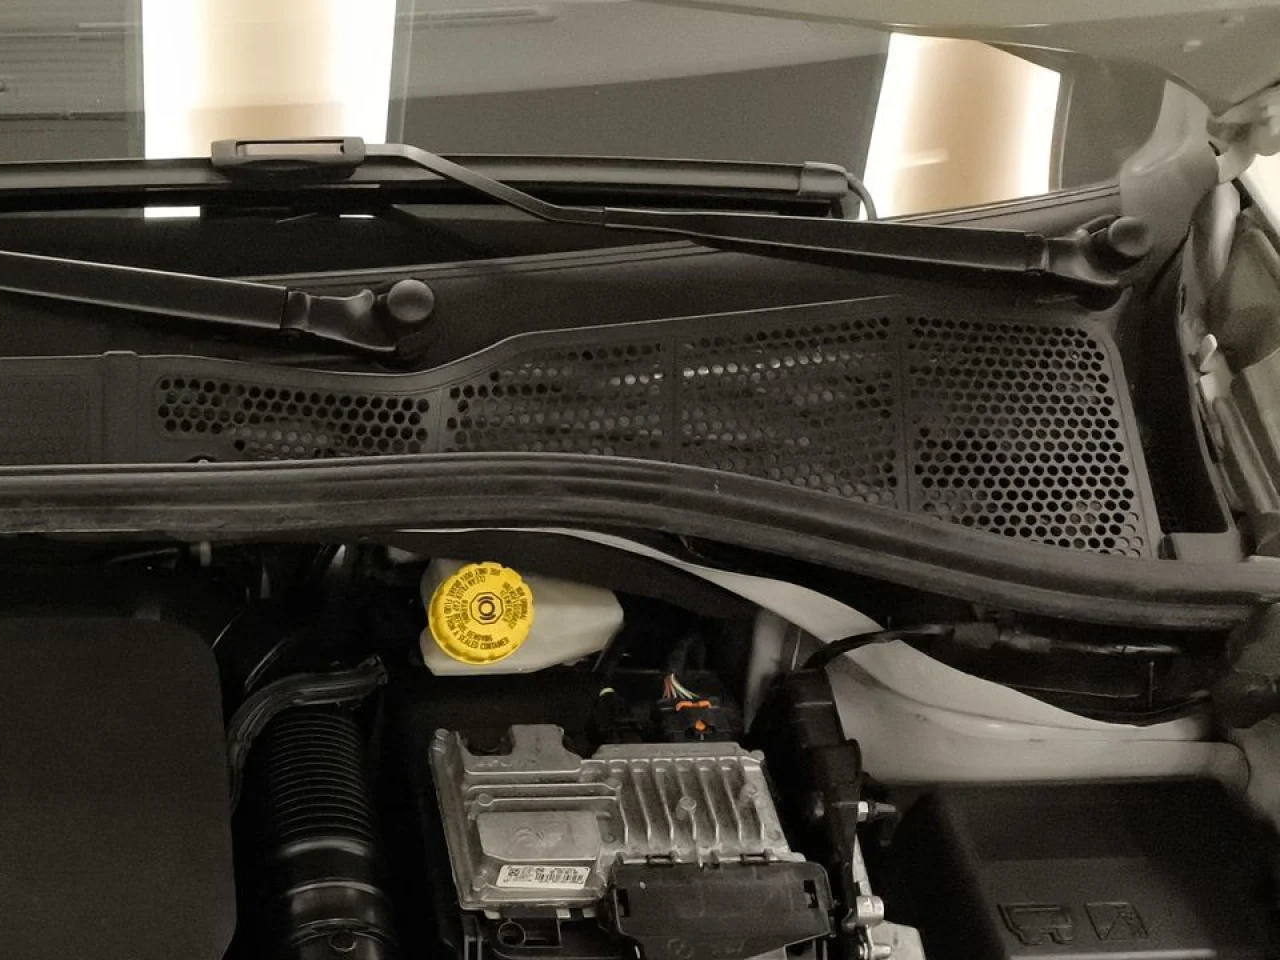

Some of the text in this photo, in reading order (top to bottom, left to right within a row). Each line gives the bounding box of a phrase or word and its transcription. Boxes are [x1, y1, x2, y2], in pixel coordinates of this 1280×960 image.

[467, 575, 486, 587] CLEAN
[443, 598, 453, 615] FLUID
[452, 599, 461, 612] CAP
[445, 614, 456, 632] FROM
[458, 634, 479, 649] SEALED
[480, 636, 510, 650] CONTAINER
